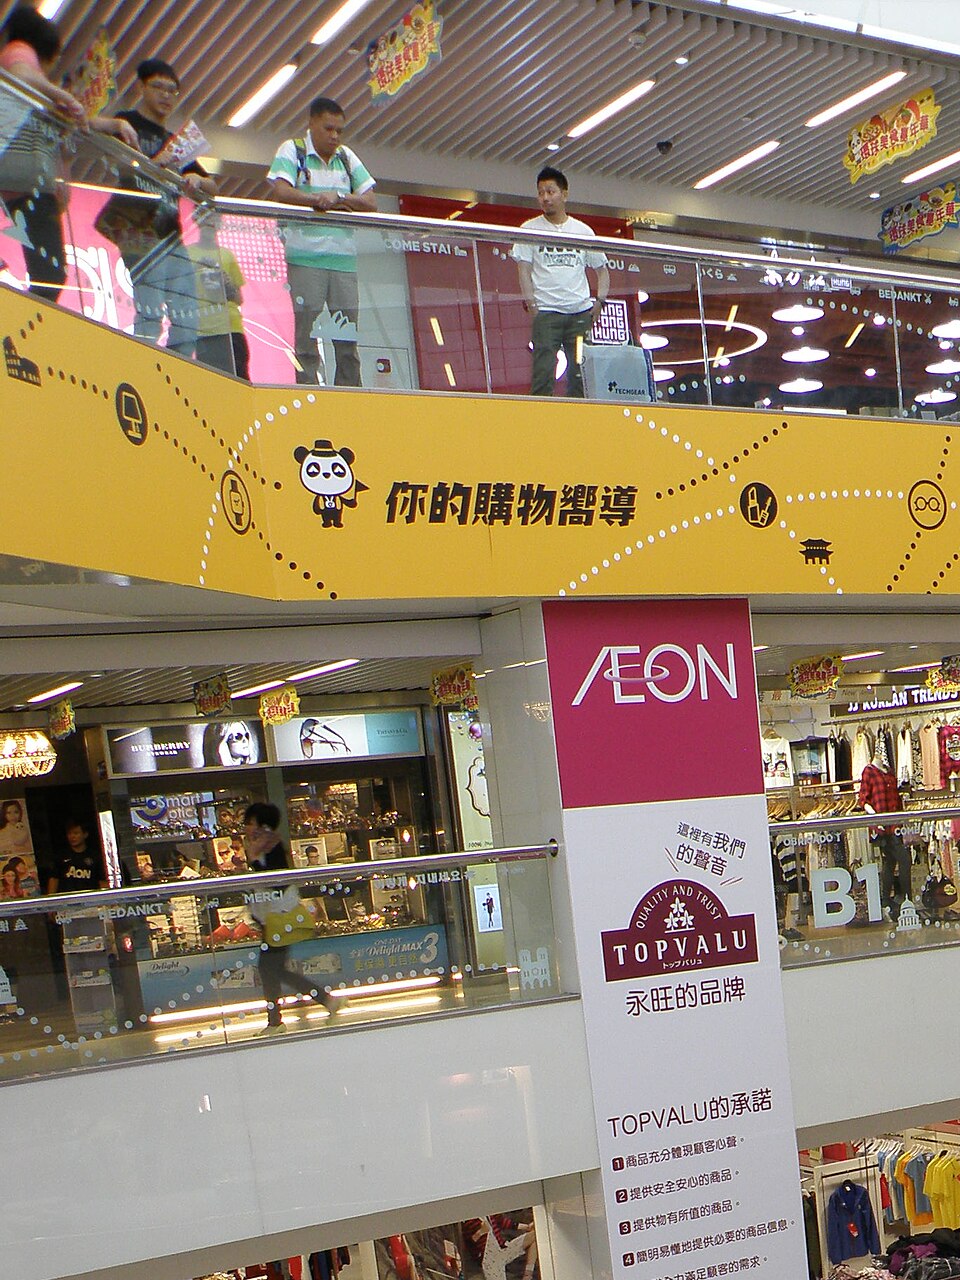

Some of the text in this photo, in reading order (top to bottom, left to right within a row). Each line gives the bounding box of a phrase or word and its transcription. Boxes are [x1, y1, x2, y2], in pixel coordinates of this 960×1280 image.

[594, 328, 625, 341] HUNG
[615, 388, 646, 396] TECHGEAR
[385, 481, 638, 527] 你的購物嚮導
[676, 821, 746, 860] 這裡有我們
[676, 843, 728, 876] 的聲音
[66, 865, 91, 879] AON
[635, 884, 722, 930] QUALITY AND TRUST
[812, 862, 884, 929] B1
[613, 929, 748, 966] TOPVALU
[626, 976, 746, 1016] 永旺的品牌
[607, 1087, 772, 1137] TOPVALU的承諾
